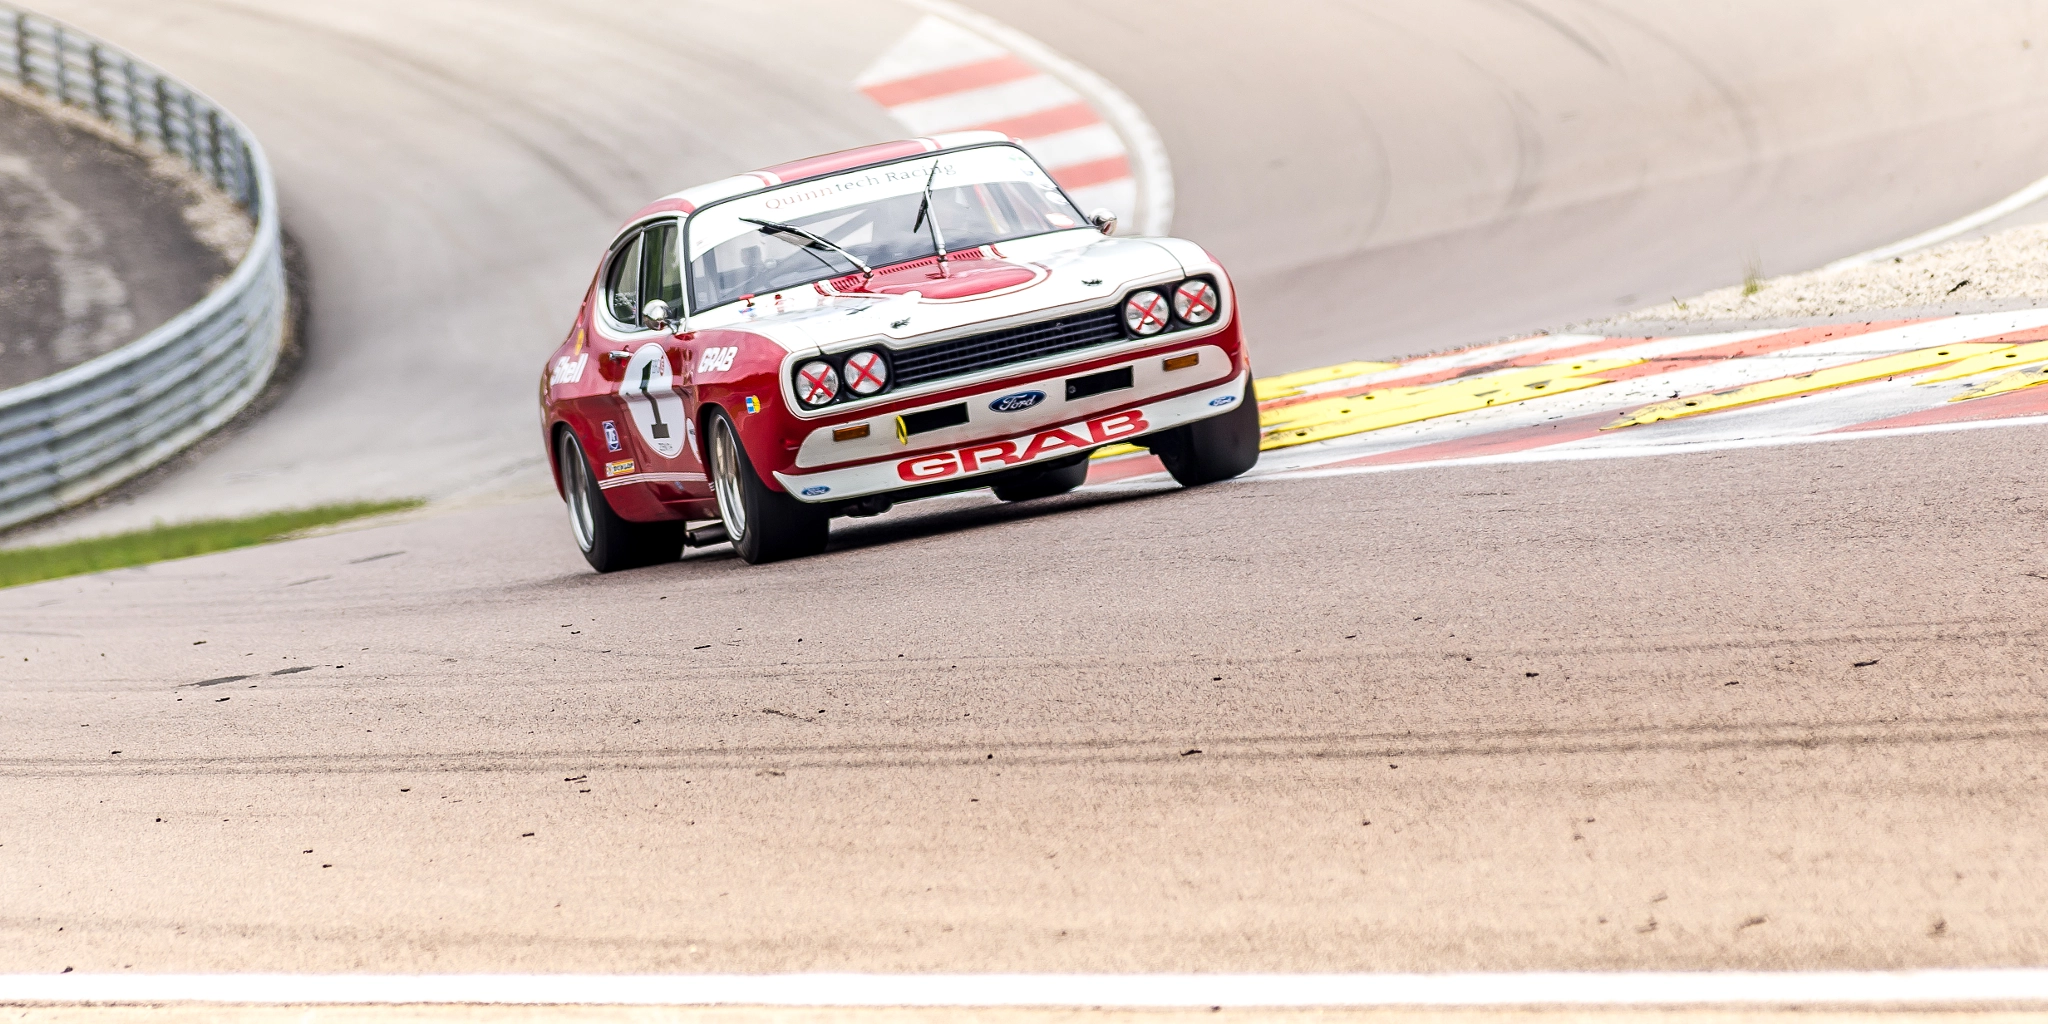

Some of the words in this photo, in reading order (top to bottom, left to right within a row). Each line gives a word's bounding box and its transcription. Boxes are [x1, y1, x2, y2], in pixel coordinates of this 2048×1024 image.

[765, 174, 880, 210] Quinntech
[885, 163, 957, 183] Racing
[550, 352, 589, 386] Shell
[698, 346, 738, 374] GRAB
[640, 360, 670, 439] 1
[998, 394, 1038, 411] Ford
[897, 409, 1149, 482] GRAB
